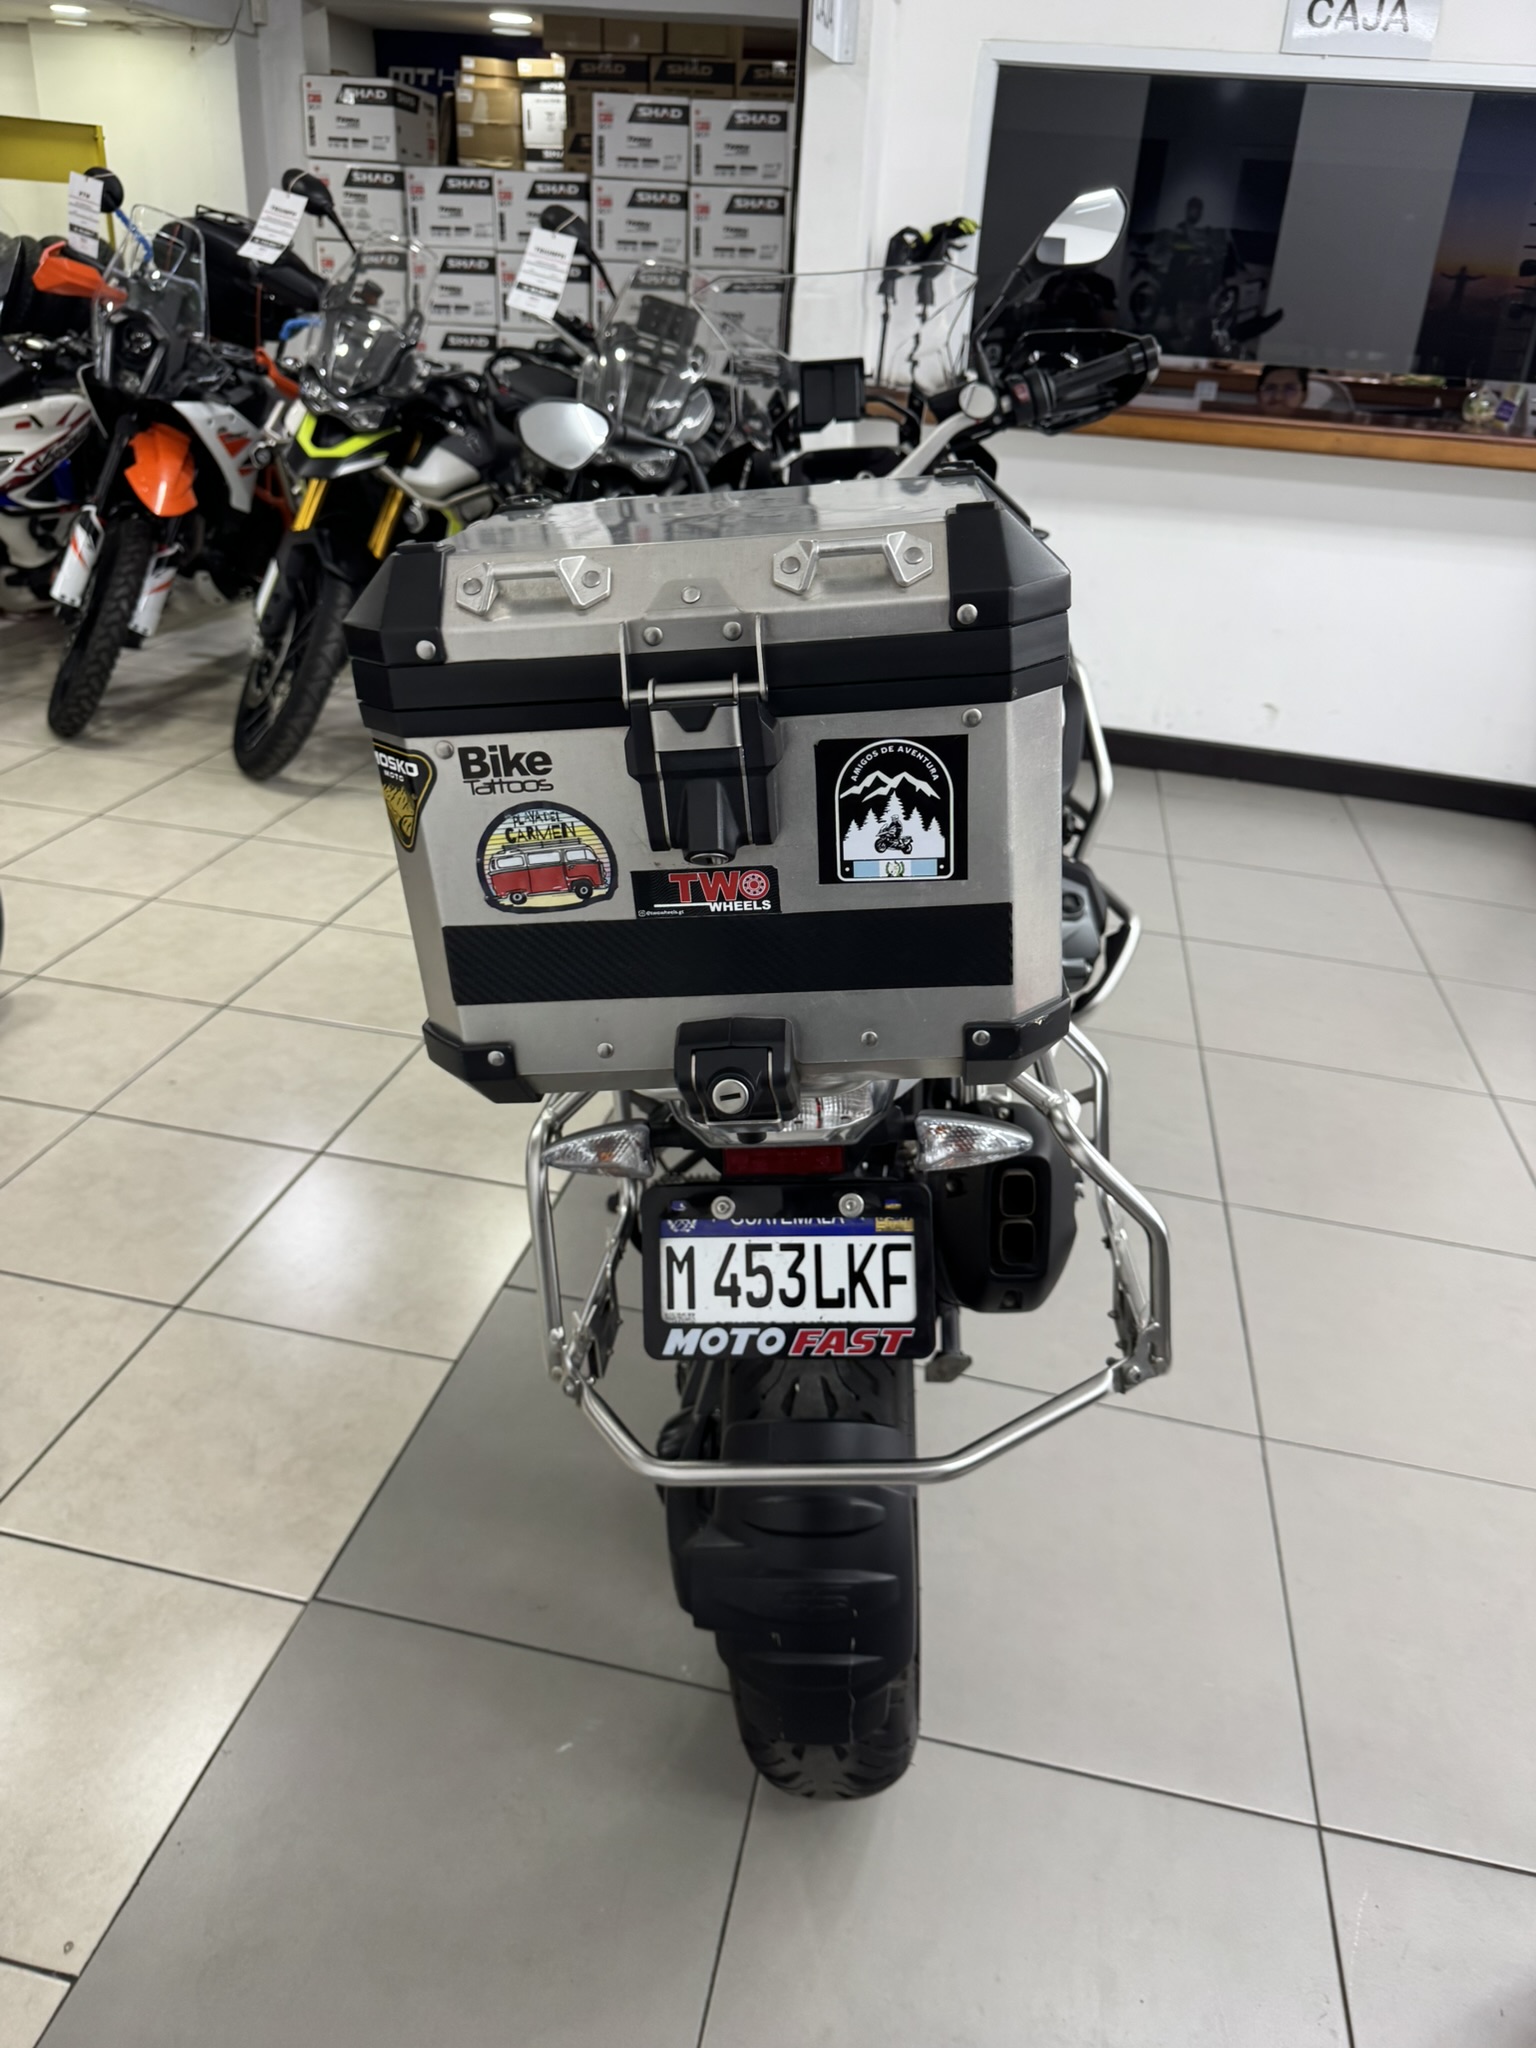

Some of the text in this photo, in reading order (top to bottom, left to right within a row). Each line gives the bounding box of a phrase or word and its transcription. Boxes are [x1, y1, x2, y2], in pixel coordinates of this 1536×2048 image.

[1307, 0, 1409, 32] CAJA
[666, 63, 713, 77] SHAD
[636, 106, 683, 119] SHAD
[733, 112, 781, 126] SHAD
[352, 171, 395, 184] SHAD
[446, 178, 490, 190] SHAD
[535, 183, 579, 196] SHAD
[634, 191, 682, 205] SHAD
[732, 197, 779, 210] SHAD
[446, 258, 490, 270] SHAD
[447, 335, 490, 347] SHAD
[458, 744, 553, 779] Bike
[850, 745, 939, 782] AMIGOS DE AVENTURA
[462, 778, 554, 795] Tattoos
[505, 822, 577, 844] CARMEN
[668, 869, 770, 903] TWO
[709, 899, 772, 912] WHEELS
[665, 1242, 913, 1310] M 453LKF
[661, 1327, 916, 1356] MOTO FAST
